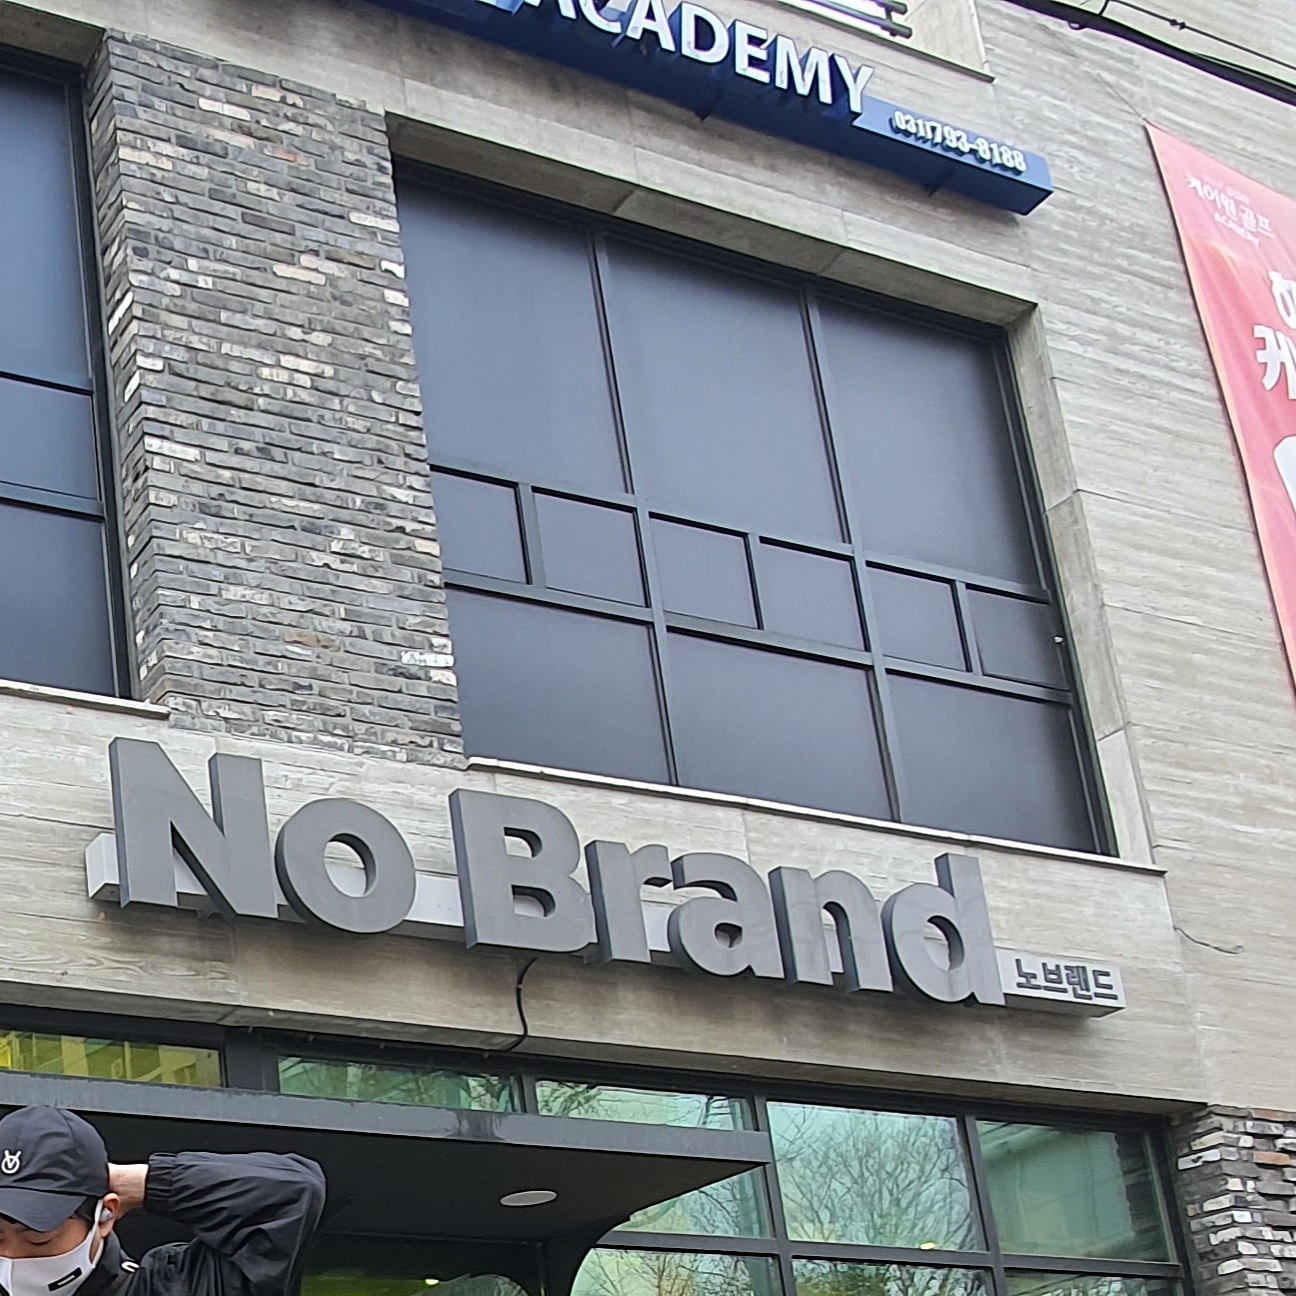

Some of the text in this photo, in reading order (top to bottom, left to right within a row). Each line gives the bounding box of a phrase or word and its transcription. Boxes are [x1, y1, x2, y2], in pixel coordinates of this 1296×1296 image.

[524, 0, 874, 113] CADEMY
[107, 736, 1006, 1007] No Brand
[1014, 958, 1119, 1001] 노브랜드
